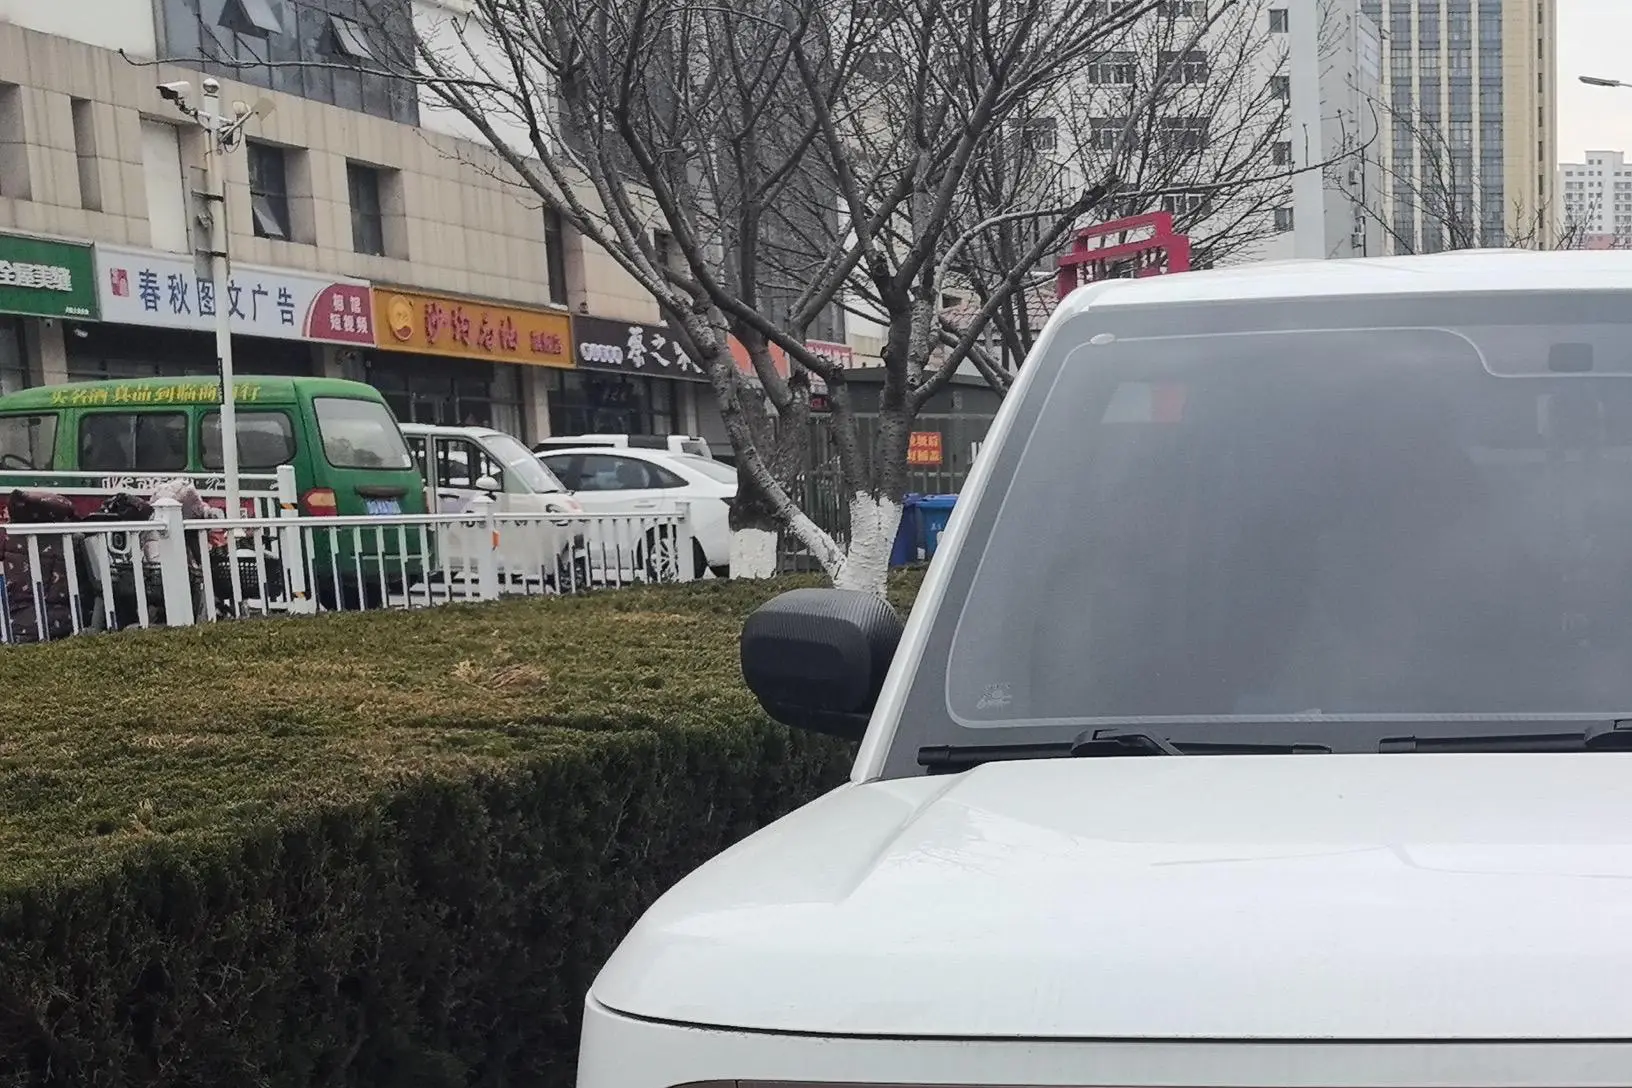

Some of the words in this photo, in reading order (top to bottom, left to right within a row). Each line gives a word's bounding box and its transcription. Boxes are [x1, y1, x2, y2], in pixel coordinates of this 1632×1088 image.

[139, 268, 295, 326] 春秋图文广告
